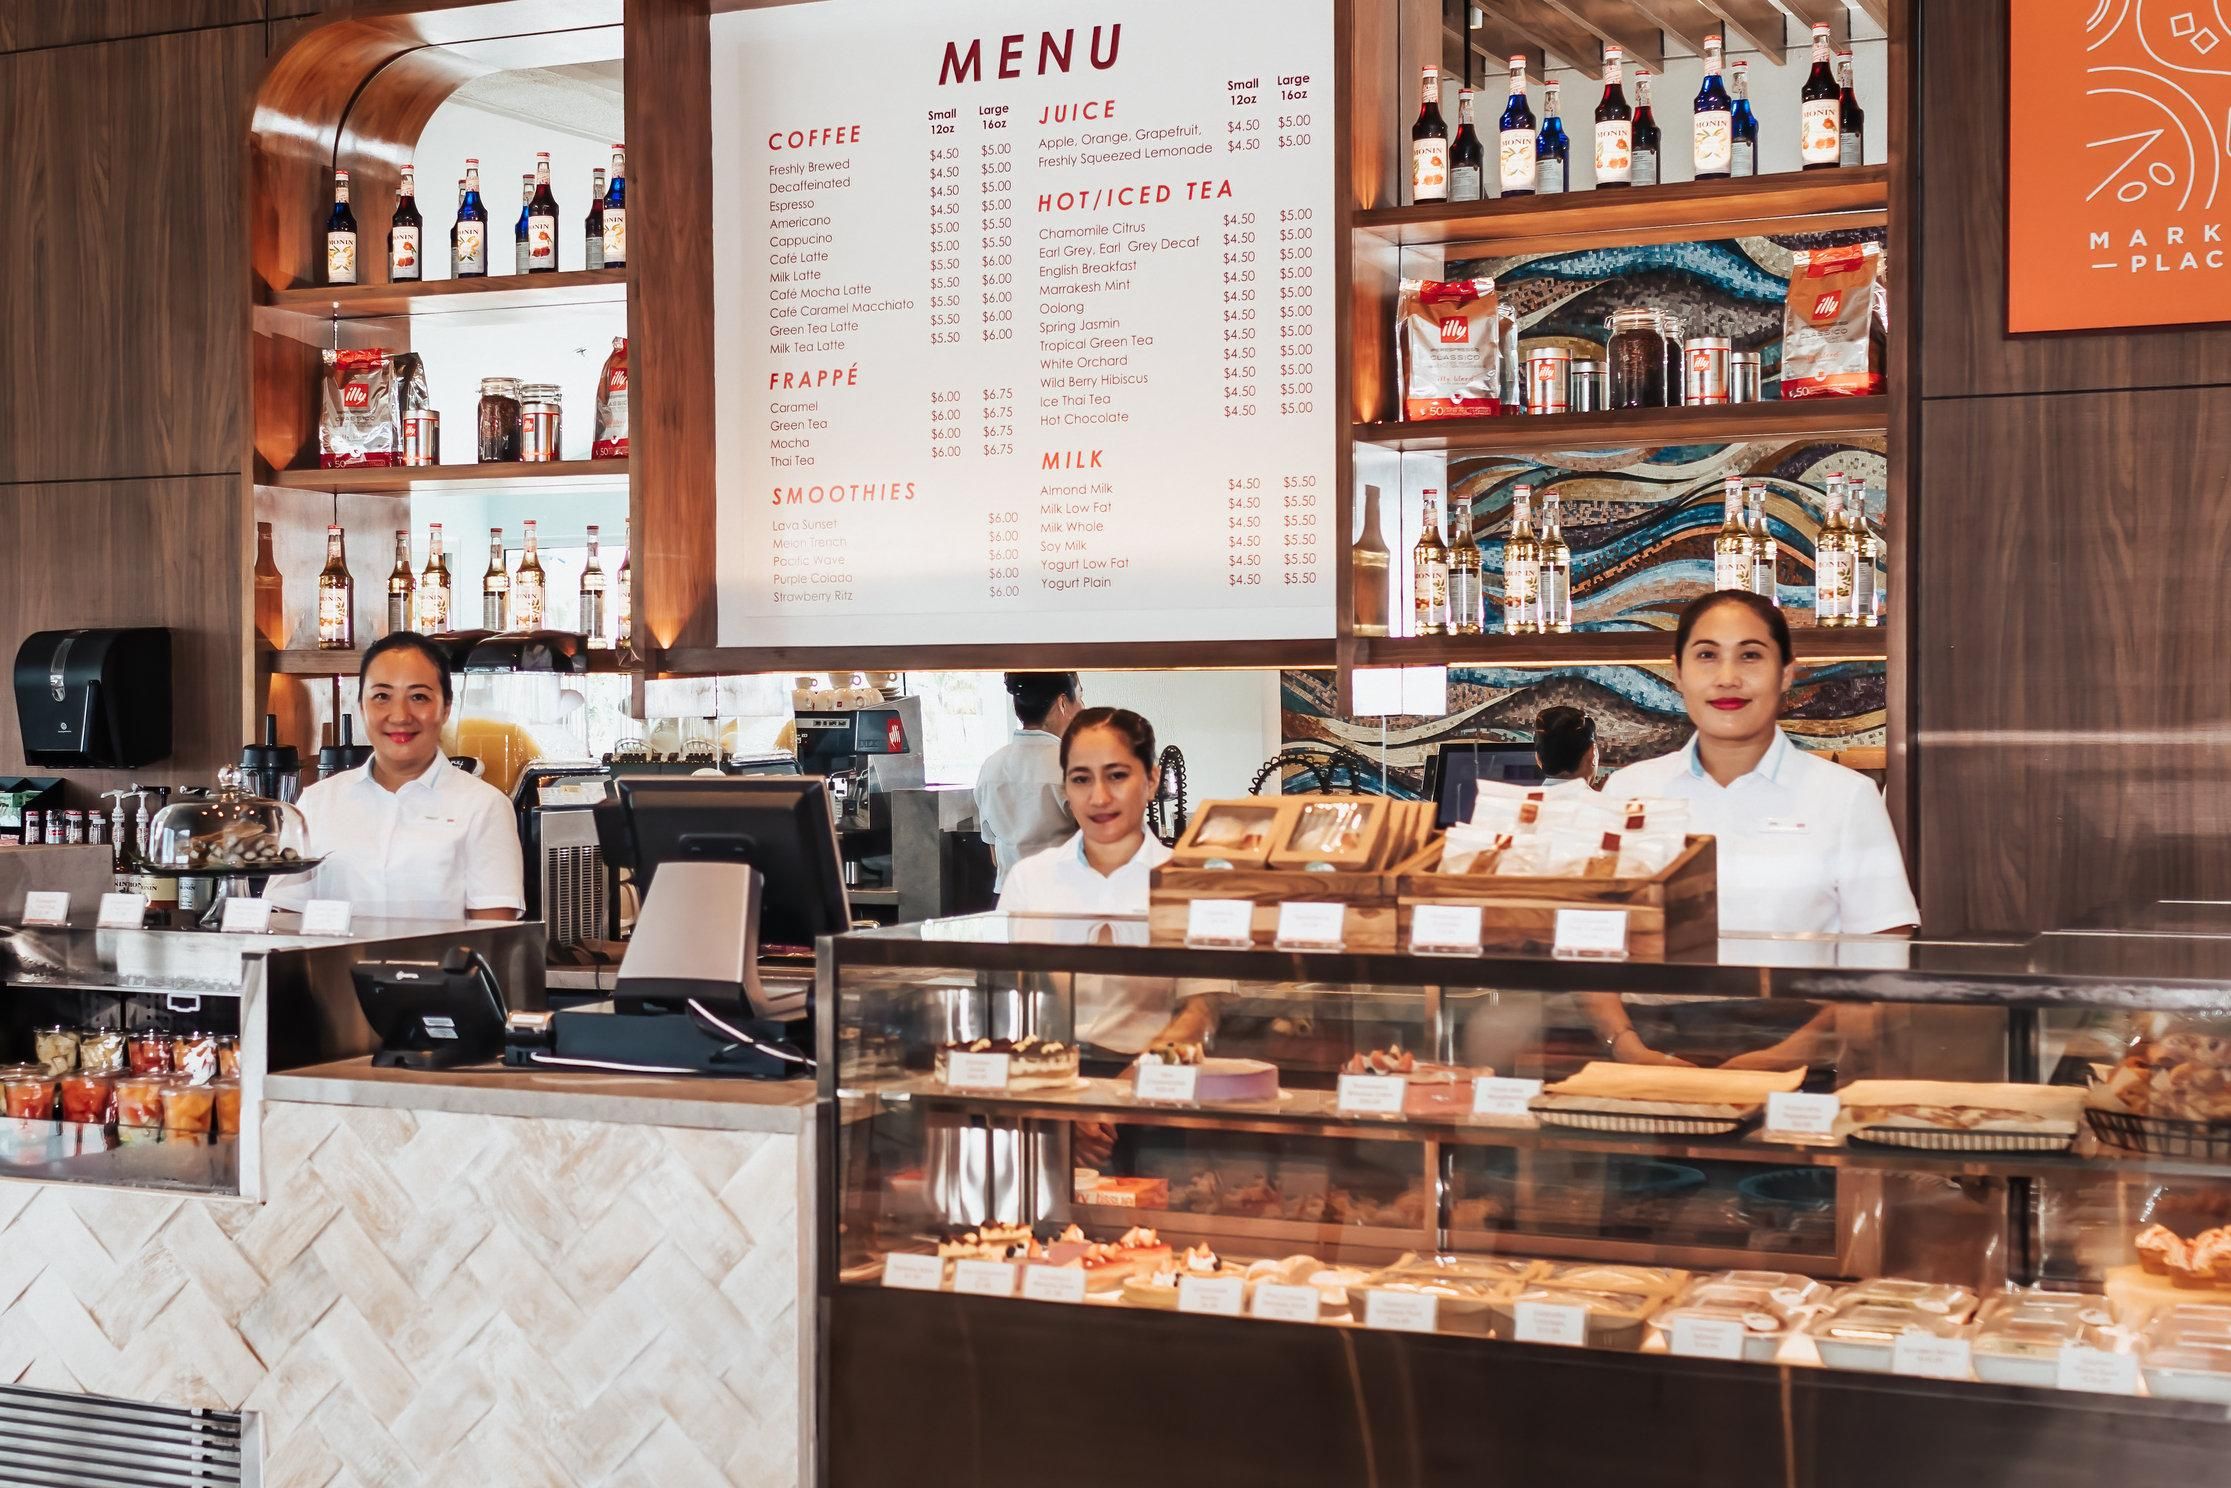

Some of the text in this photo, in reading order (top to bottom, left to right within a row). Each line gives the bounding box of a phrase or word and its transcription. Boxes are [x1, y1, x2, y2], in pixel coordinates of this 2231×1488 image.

[938, 24, 1121, 85] MENU
[1228, 75, 1309, 90] Small Large
[1232, 90, 1307, 105] 12oz 16oz
[929, 106, 1009, 120] Small Large
[1039, 100, 1115, 124] JUICE
[1803, 108, 1836, 118] MONIN
[932, 120, 1006, 134] 12oz 16oz
[1228, 119, 1259, 134] $4.50
[1278, 114, 1310, 129] $5.00
[1696, 119, 1728, 128] MONIN
[769, 125, 860, 150] COFFEE
[1502, 138, 1532, 146] MONIN
[770, 143, 1011, 175] Freshly Brewed $4.50 $5.00
[1039, 134, 1310, 167] Freshly Squeezed Lemonade $4.50 $5.00
[770, 177, 850, 193] Decaffeinated
[1038, 180, 1232, 212] HOT/ICED TEA
[770, 200, 814, 213] Espresso
[770, 217, 831, 229] Americano
[1039, 208, 1312, 239] Chamomile Citrus $4.50 $5.00
[770, 217, 1011, 248] Cappucino $5.00 $5.50
[2090, 223, 2221, 250] MARK
[1040, 246, 1060, 258] Earl
[1100, 242, 1120, 254] Earl
[1128, 241, 1157, 252] Grey
[1161, 236, 1199, 249] Decaf
[770, 251, 828, 265] Café Latte
[2131, 250, 2223, 273] PLAC
[770, 270, 821, 282] Milk Latte
[1040, 260, 1136, 278] English Breakfast
[770, 284, 871, 301] Café Mocha Latte
[1040, 280, 1130, 295] Marrakesh Mint
[770, 291, 1012, 318] Café Caramel Macchiato $5.50 $6.00
[1040, 286, 1312, 314] Oolong $4.50 $5.00
[1814, 295, 1839, 317] illy
[770, 321, 858, 336] Green Tea Latte
[1040, 318, 1120, 334] Spring Jasmin
[1441, 319, 1467, 341] illy
[770, 328, 1012, 353] Milk Tea Latte $5.50 $6.00
[1040, 335, 1153, 352] Tropical Green Tea
[1041, 355, 1127, 369] White Orchard
[1694, 355, 1709, 370] illy
[770, 362, 857, 390] FRAPPÉ
[1041, 363, 1312, 388] Wild Berry Hibiscus $4.50 $5.00
[1539, 366, 1555, 379] illy
[345, 387, 367, 405] illy
[770, 388, 1012, 413] Caramel $6.00 $6.75
[1041, 394, 1110, 407] Ice Thai Tea
[1041, 401, 1313, 425] Hot Chocolate $4.50 $5.00
[770, 419, 827, 431] Green Tea
[771, 425, 1013, 448] Mocha $6.00 $6.75
[771, 455, 814, 466] Thai Tea
[1042, 450, 1102, 470] MILK
[772, 482, 915, 505] SMOOTHIES
[1040, 476, 1316, 495] Almond Milk $4.50 $5.50
[1041, 502, 1111, 514] Milk Low Fat
[773, 512, 1018, 531] Lava Sunset $6.00
[1041, 514, 1316, 532] Milk Whole $4.50 $5.50
[989, 529, 1018, 543] $6.00
[988, 547, 1019, 562] $6.00
[1040, 540, 1087, 553] Soy Milk
[1041, 553, 1316, 572] Yogurt Low Fat $4.50 $5.50
[989, 567, 1019, 580] $6.00
[1042, 577, 1111, 591] Yogurt Plain
[773, 585, 1019, 602] Strawberry Ritz $6.00
